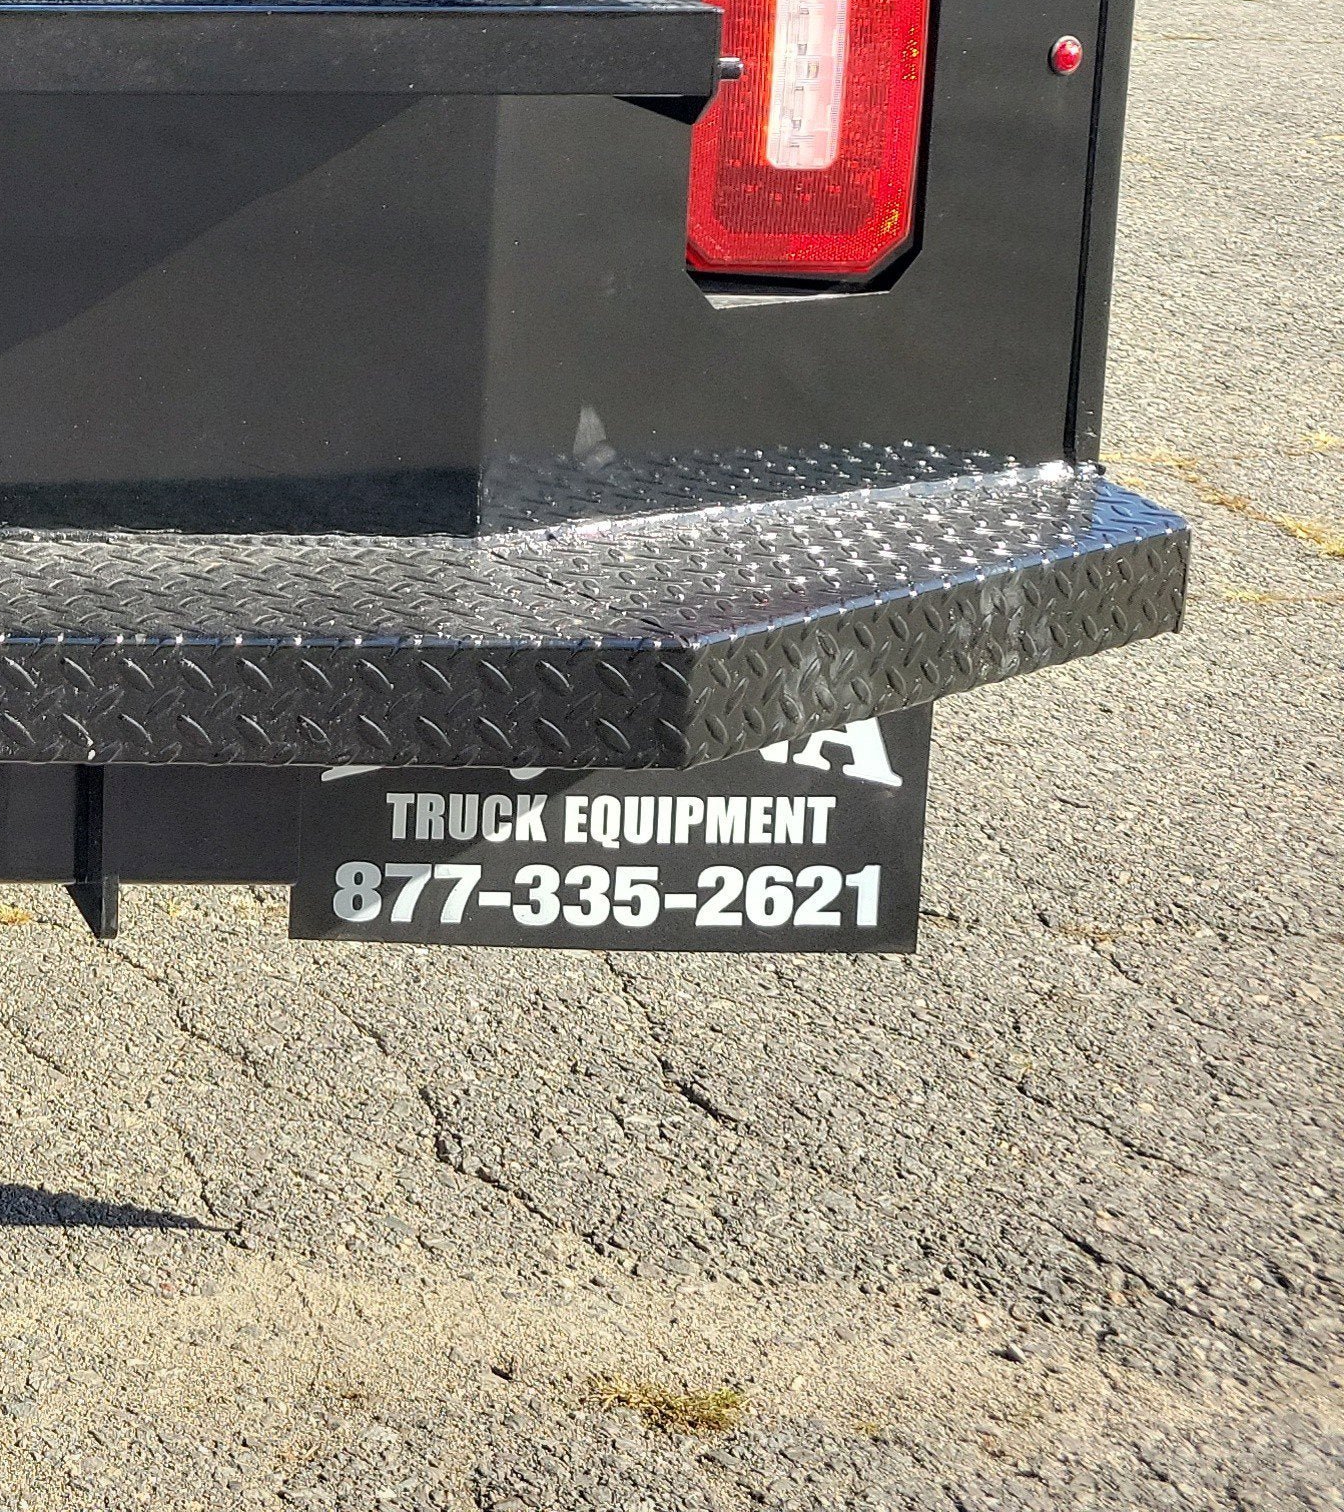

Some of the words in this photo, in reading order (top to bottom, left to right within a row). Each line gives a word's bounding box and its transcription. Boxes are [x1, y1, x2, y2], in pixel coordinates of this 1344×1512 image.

[385, 792, 549, 841] TRUCK
[563, 795, 837, 849] EQUIPMENT
[332, 861, 882, 928] 877-335-2621
